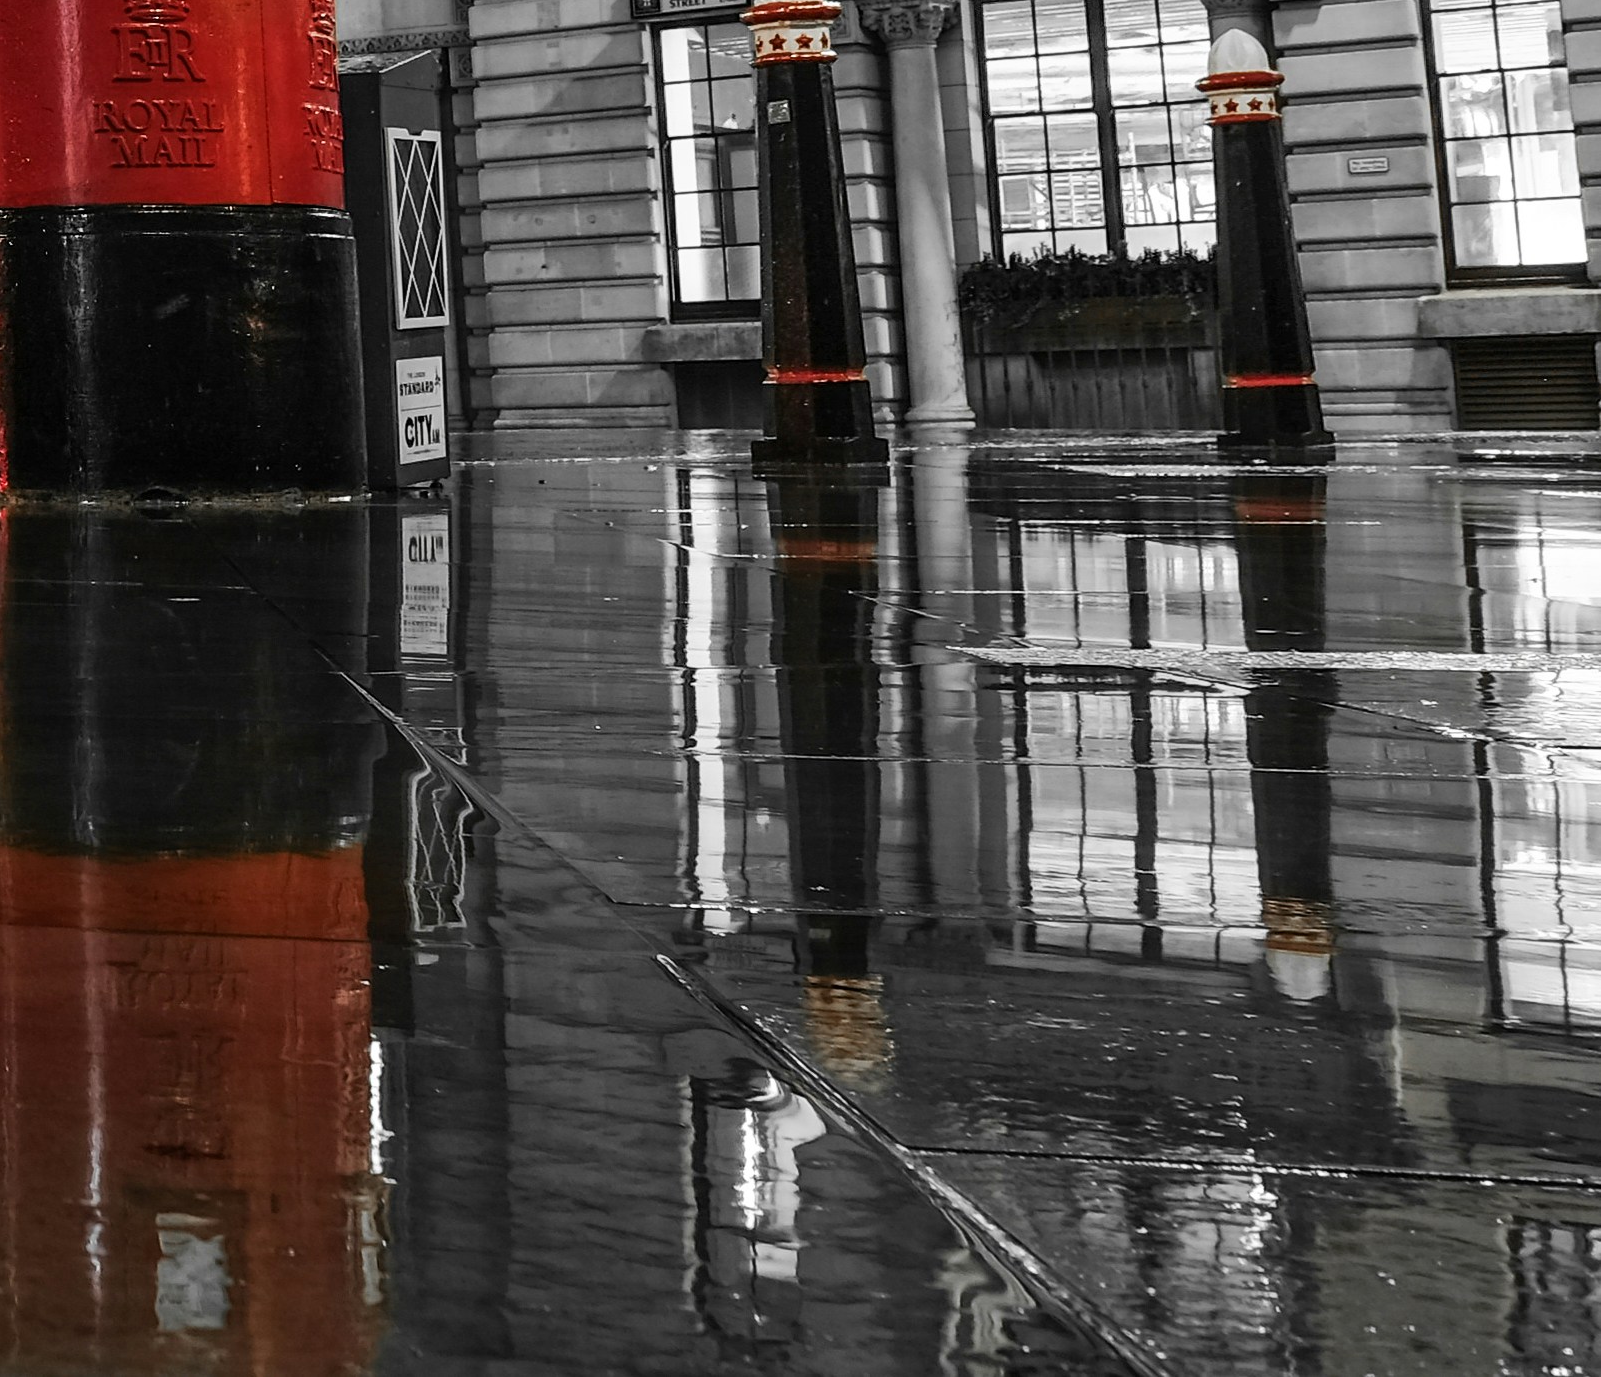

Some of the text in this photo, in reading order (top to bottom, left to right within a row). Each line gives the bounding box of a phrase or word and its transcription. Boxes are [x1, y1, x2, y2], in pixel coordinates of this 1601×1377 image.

[91, 98, 226, 134] ROYAL
[110, 134, 217, 169] MAIL
[404, 413, 432, 449] CITY
